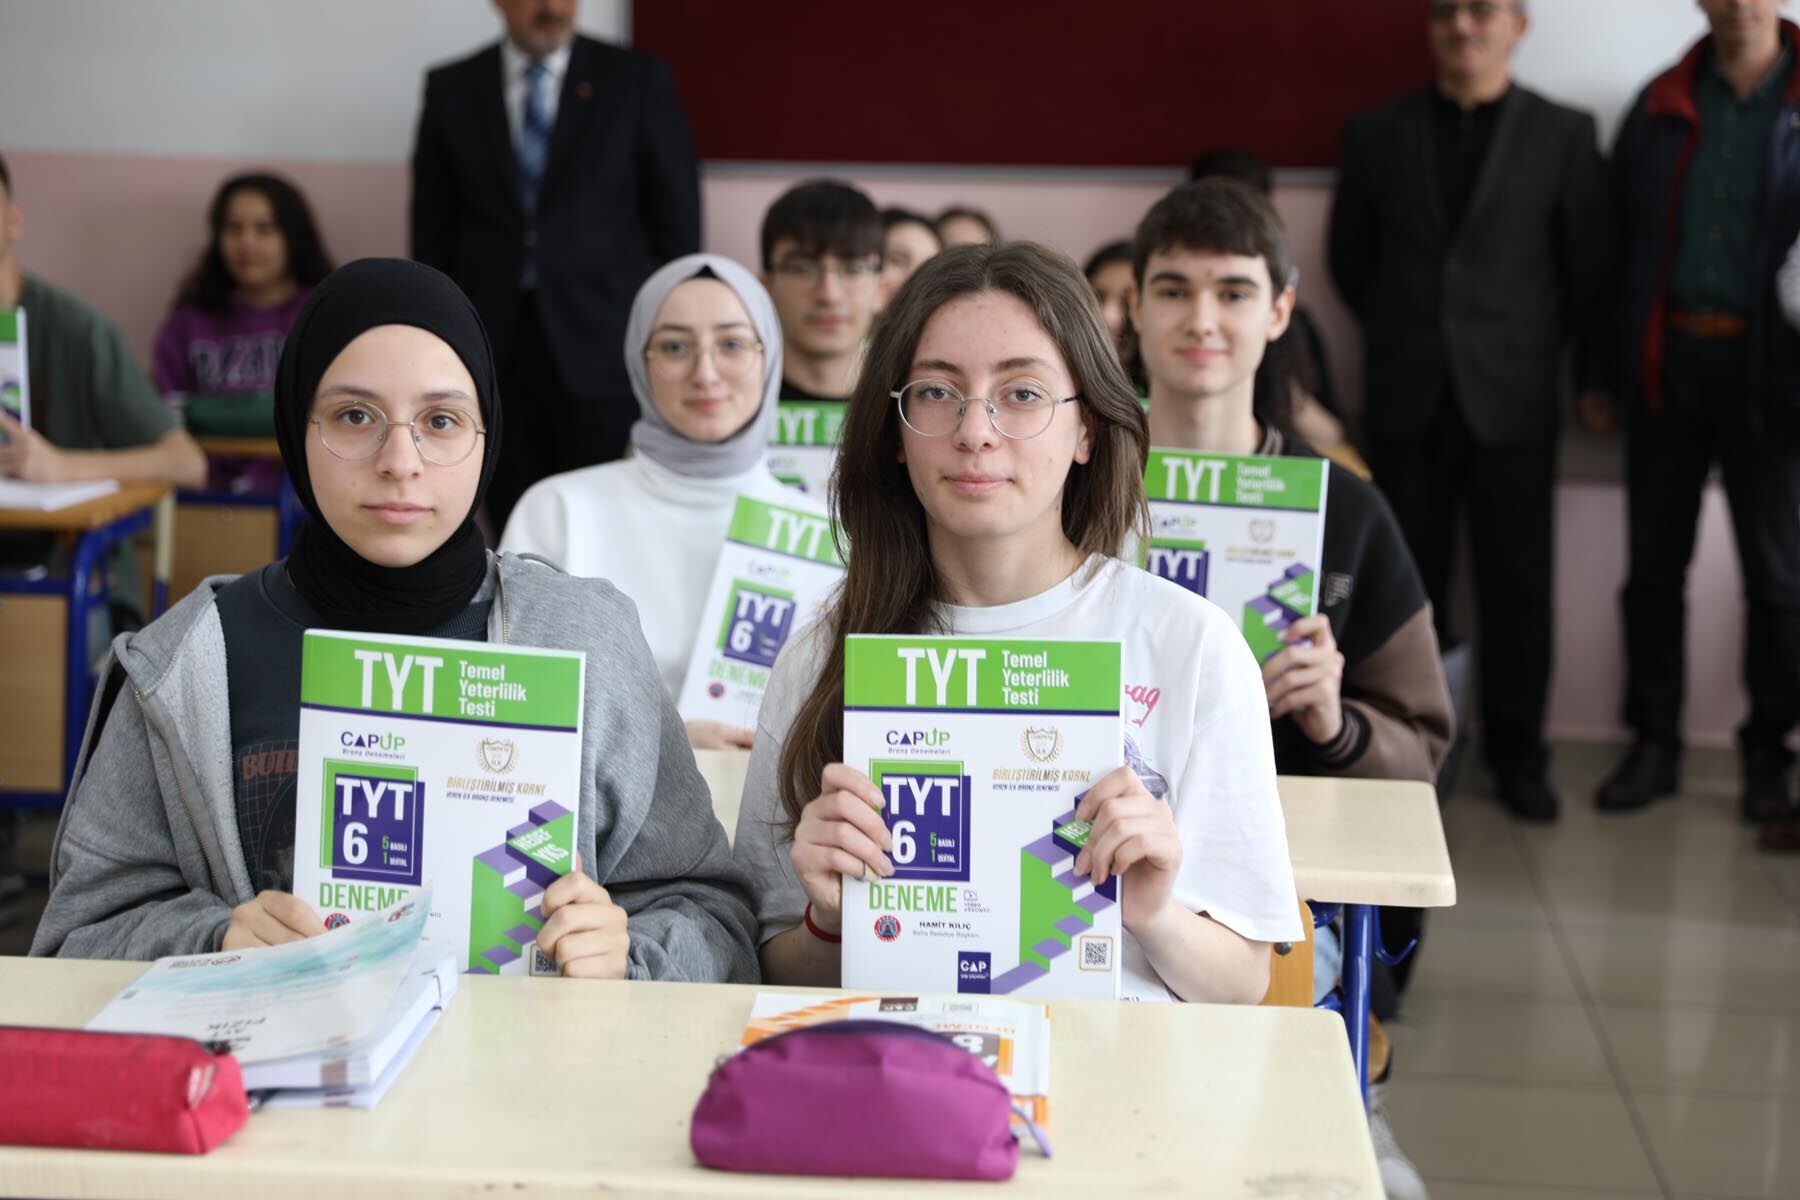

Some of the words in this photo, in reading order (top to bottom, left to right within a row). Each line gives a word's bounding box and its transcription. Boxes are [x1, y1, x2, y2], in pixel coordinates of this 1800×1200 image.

[1162, 457, 1227, 503] TYT
[766, 508, 828, 561] TYT
[1150, 549, 1202, 581] TYT
[737, 588, 791, 628] TYT
[730, 619, 755, 653] 6
[459, 660, 505, 681] Temel
[1002, 650, 1047, 669] Temel
[354, 649, 443, 713] TYT
[459, 679, 527, 702] Yeterlilik
[897, 648, 986, 706] TYT
[1002, 668, 1070, 688] Yeterlilik
[458, 697, 496, 718] Testi
[1002, 687, 1039, 706] Testi
[335, 777, 413, 821] TYT
[882, 776, 959, 816] TYT
[343, 822, 368, 864] 6
[891, 821, 916, 864] 6
[930, 832, 937, 847] 5
[931, 849, 936, 863] 1
[869, 883, 958, 912] DENEME
[919, 921, 946, 929] HAMİT
